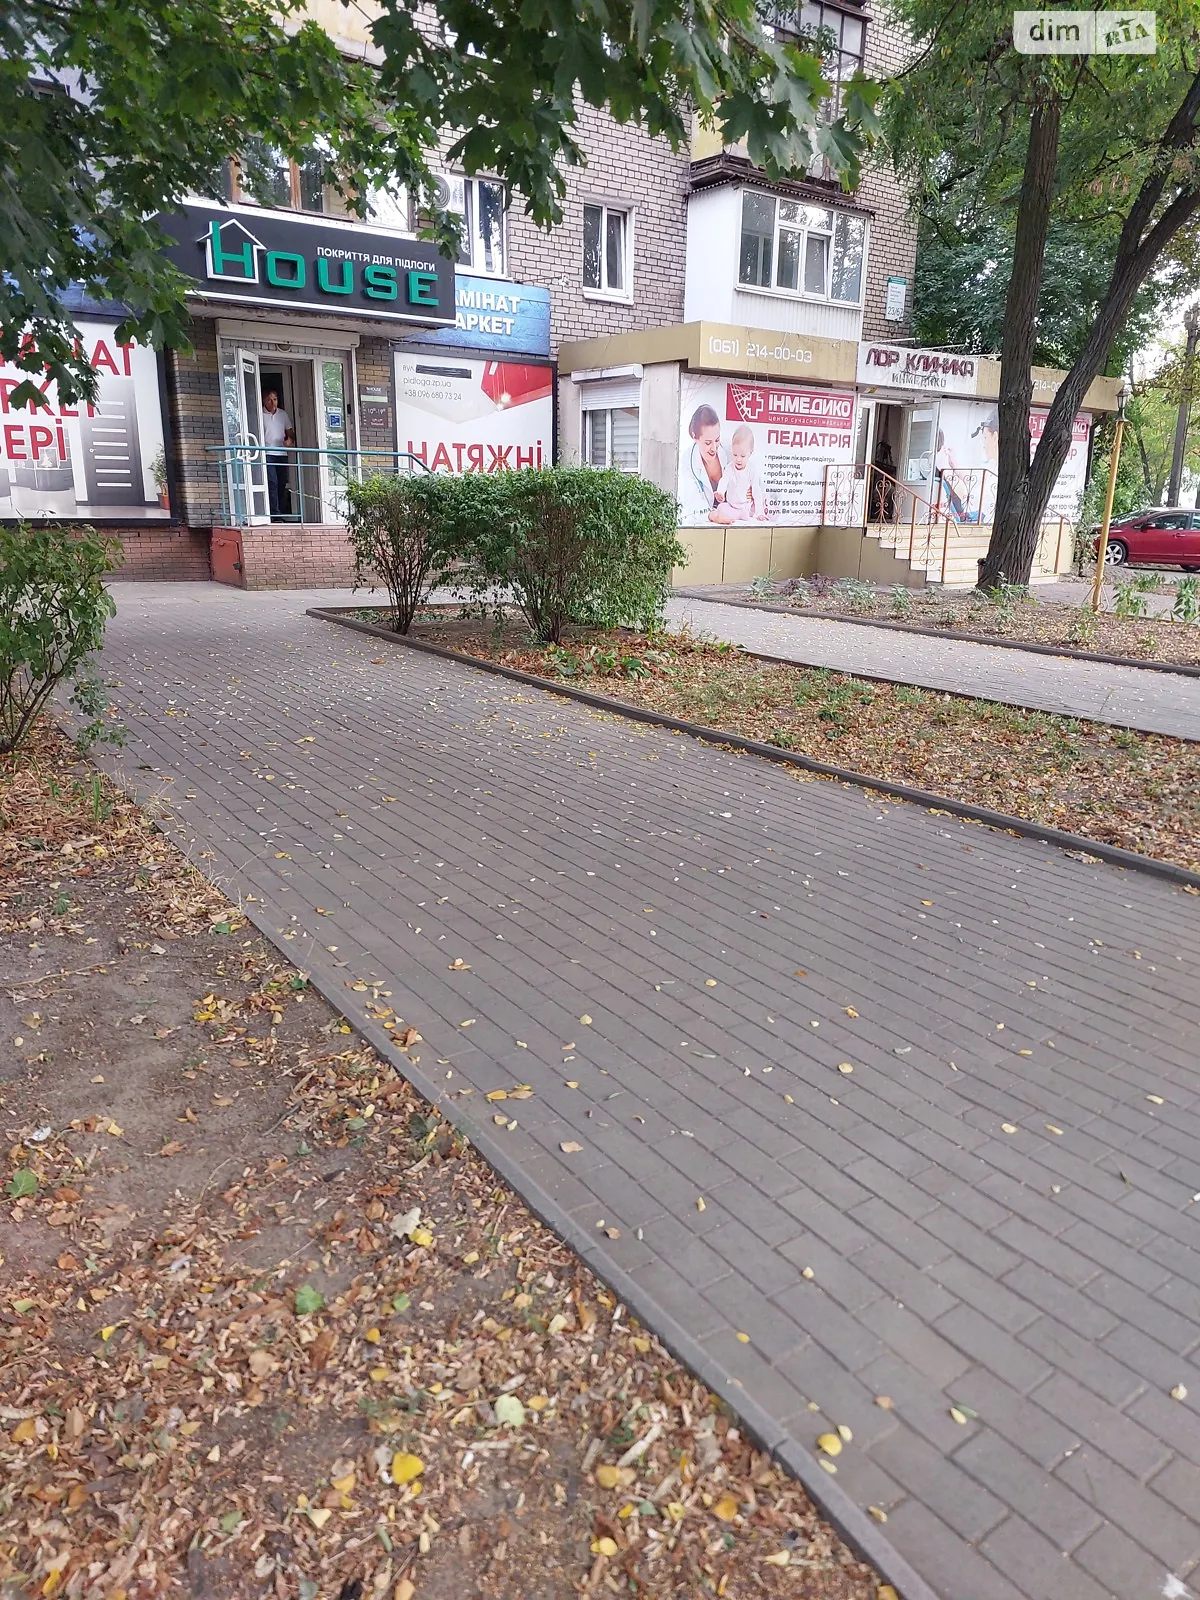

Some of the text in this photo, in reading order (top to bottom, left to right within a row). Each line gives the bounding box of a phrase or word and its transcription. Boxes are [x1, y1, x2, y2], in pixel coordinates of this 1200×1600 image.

[211, 220, 440, 306] HOUSE
[317, 246, 436, 272] ПОКРИТТЯ ДЛЯ ПІДЛОГИ
[709, 336, 812, 363] (061) 214-00-03
[866, 347, 975, 378] ЛОР КЛИНИКА
[768, 394, 851, 417] ІНМЕДИКО
[767, 429, 851, 448] ПЕДІАТРІЯ
[767, 471, 786, 479] проба
